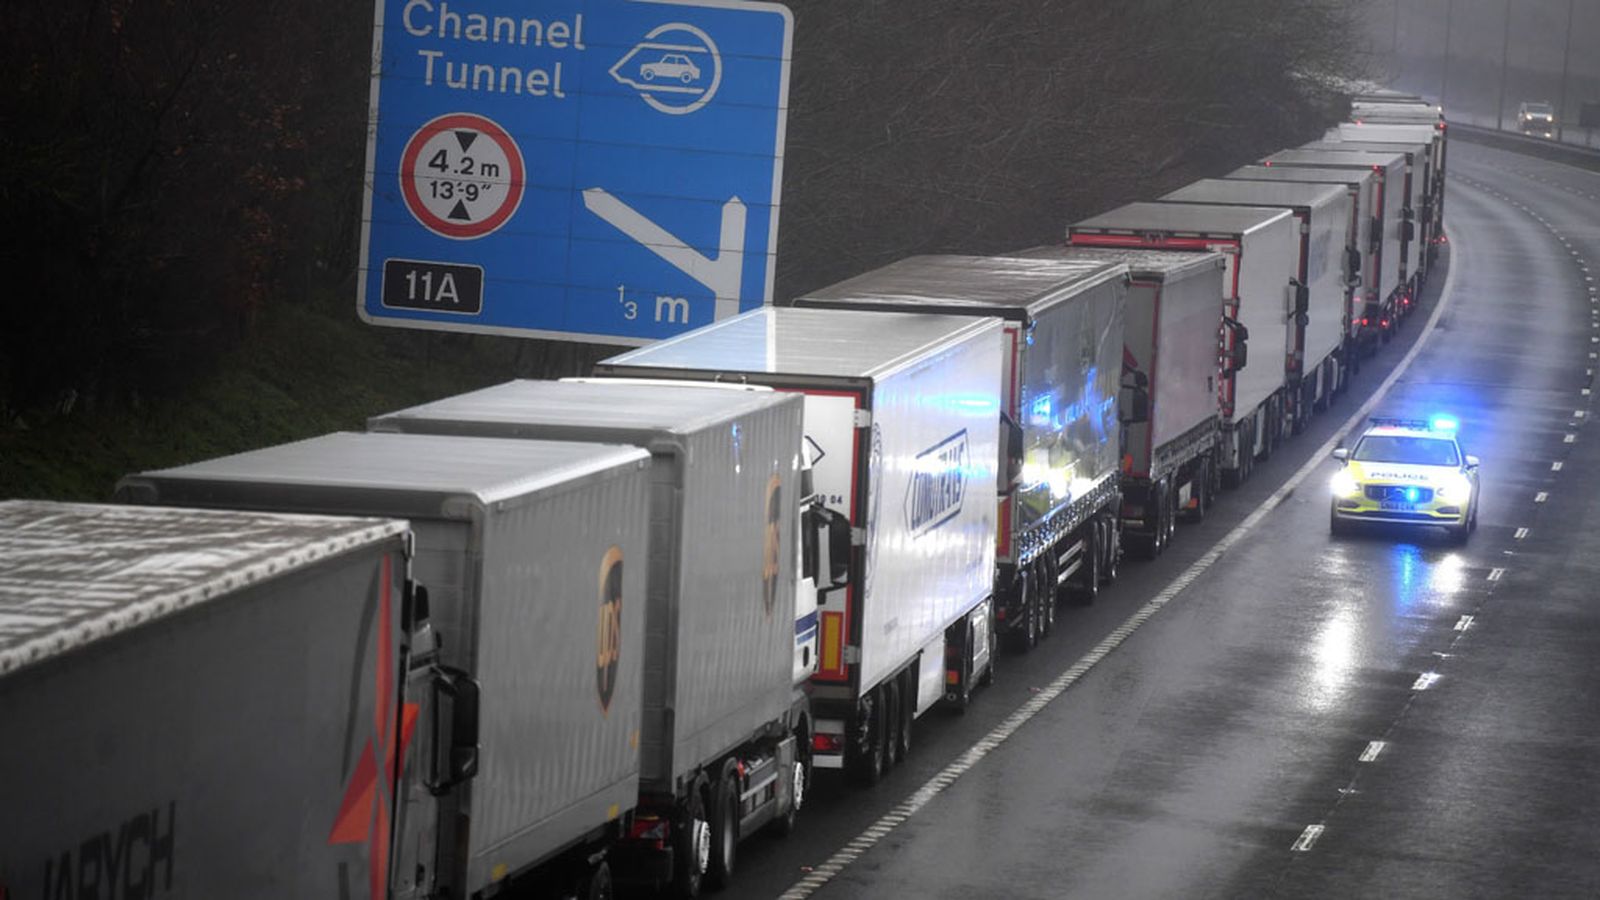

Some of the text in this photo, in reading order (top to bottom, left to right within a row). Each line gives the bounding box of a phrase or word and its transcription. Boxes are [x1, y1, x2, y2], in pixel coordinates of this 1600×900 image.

[402, 0, 585, 50] Channel
[418, 50, 565, 98] Tunnel
[428, 149, 499, 177] 4.2 m
[406, 270, 459, 303] 11A
[655, 296, 689, 324] m
[1371, 472, 1429, 480] POLICE
[597, 598, 622, 668] UPS
